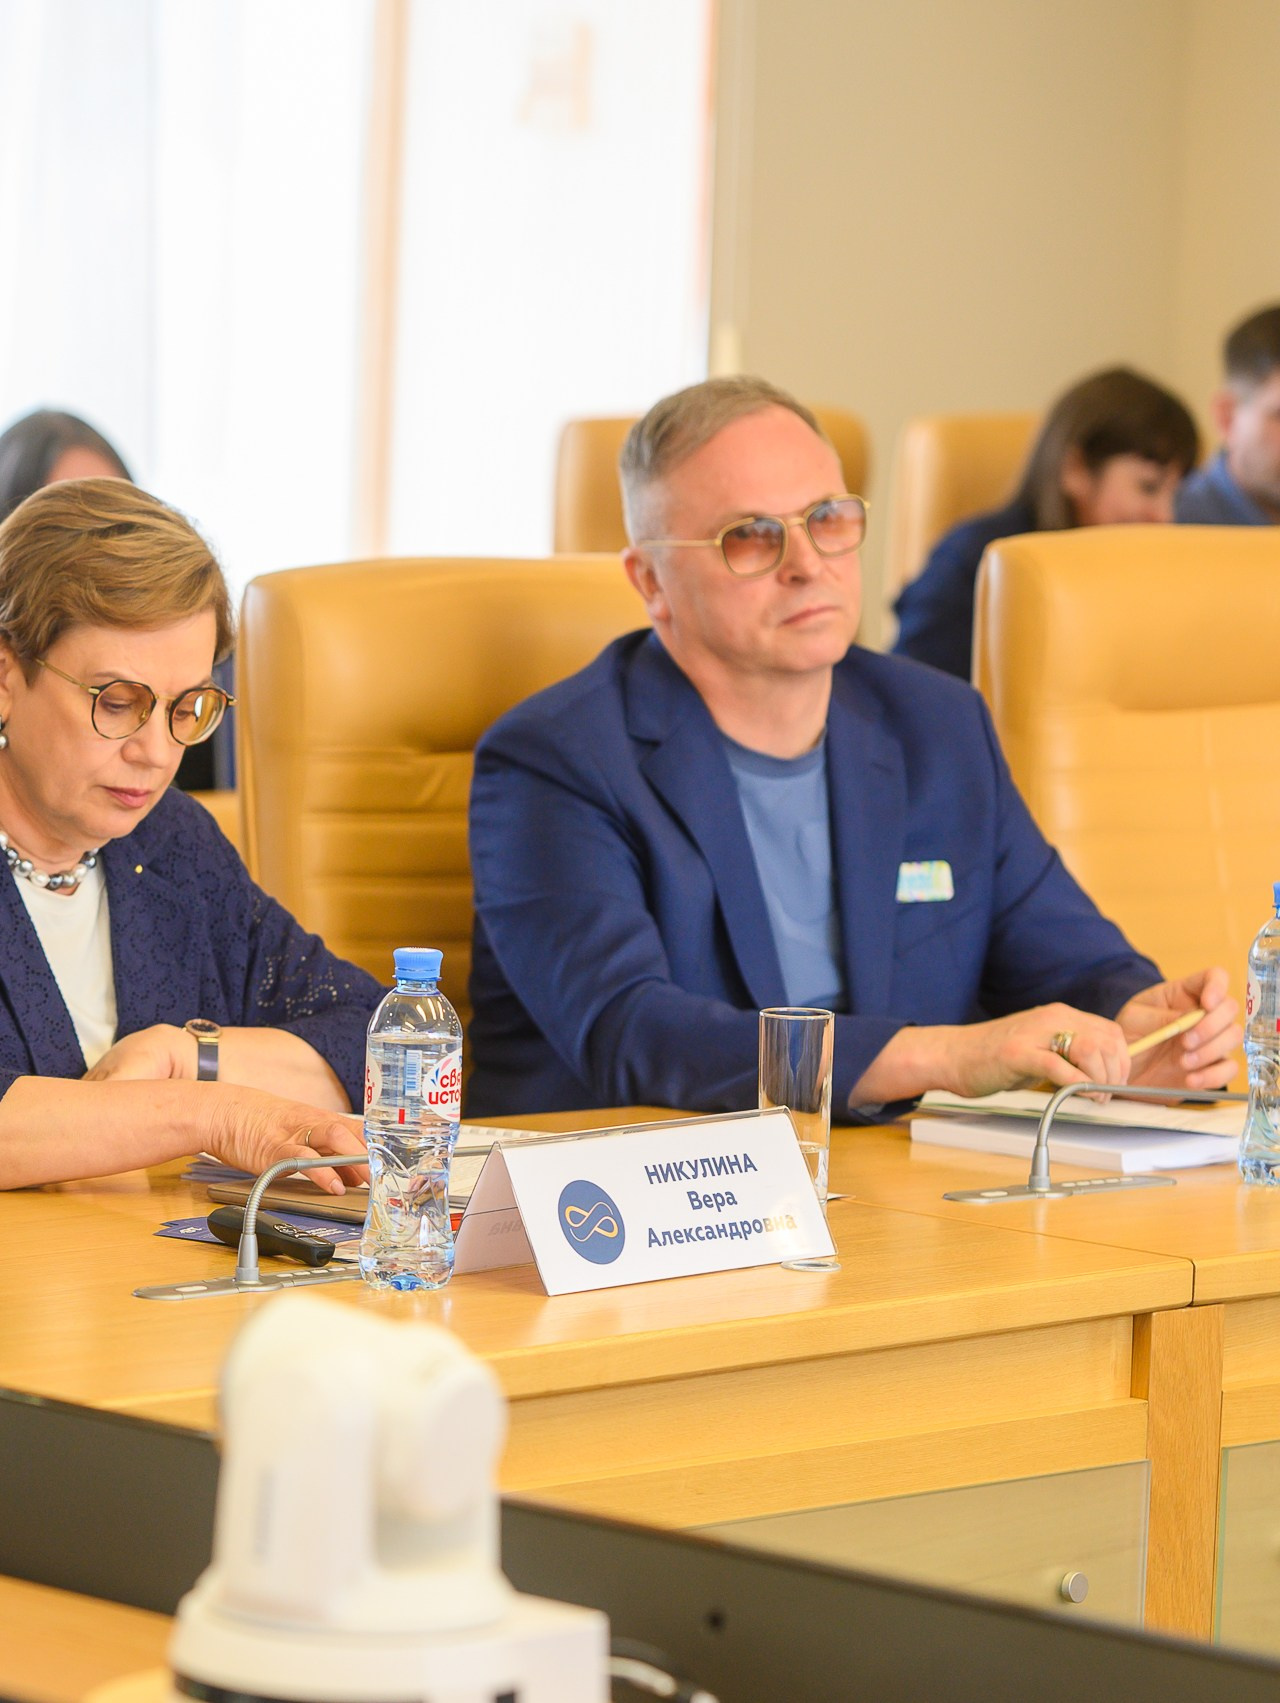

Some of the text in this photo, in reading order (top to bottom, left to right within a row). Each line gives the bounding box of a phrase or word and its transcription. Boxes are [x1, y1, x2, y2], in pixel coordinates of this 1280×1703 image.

[644, 1153, 758, 1185] НИКУЛИНА
[687, 1189, 738, 1212] Вера
[647, 1214, 797, 1248] Александровна
